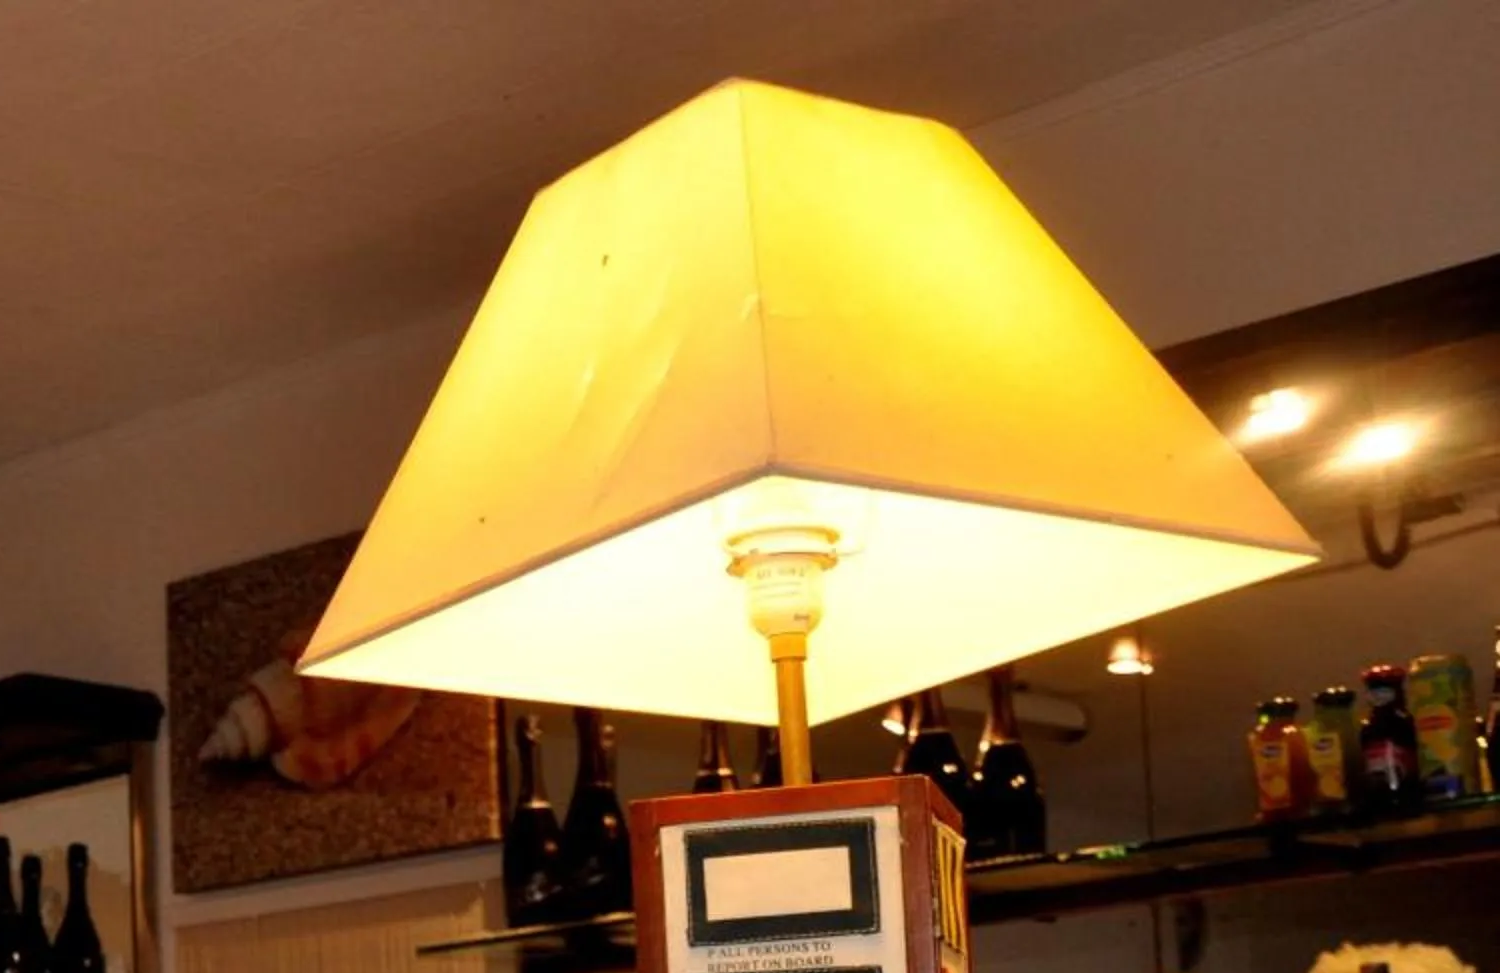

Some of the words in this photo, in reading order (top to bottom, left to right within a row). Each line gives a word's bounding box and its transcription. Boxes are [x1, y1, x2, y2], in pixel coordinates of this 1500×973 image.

[747, 941, 810, 957] PERSONS
[813, 940, 832, 953] TO
[785, 956, 834, 968] BOARD
